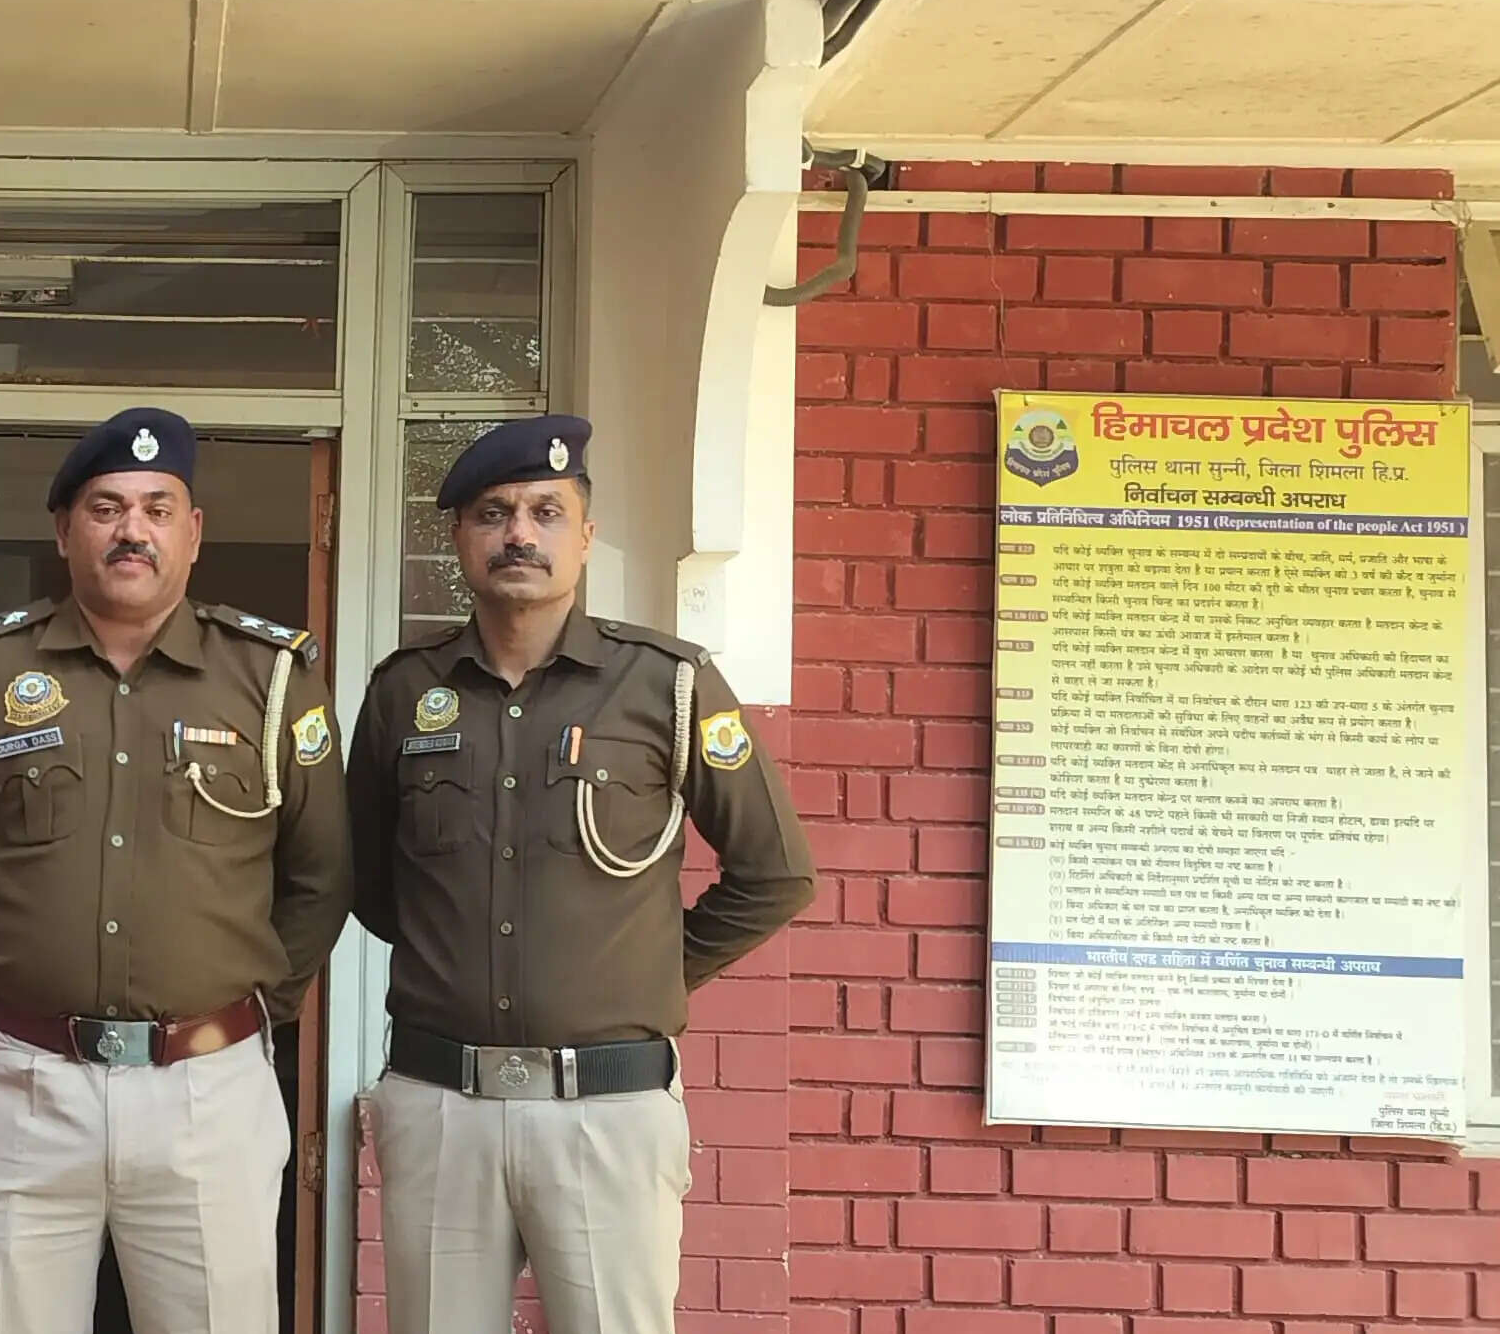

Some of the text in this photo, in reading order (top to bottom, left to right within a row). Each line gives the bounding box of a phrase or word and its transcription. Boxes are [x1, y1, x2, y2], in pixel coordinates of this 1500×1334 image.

[1091, 402, 1438, 458] हिमाचल प्रदेश पुलिस
[1110, 454, 1157, 478] पुलिस
[1165, 461, 1201, 475] थाना
[1259, 457, 1301, 477] जिला
[1309, 459, 1365, 480] शिमला
[1124, 482, 1346, 508] निर्वाचन सम्बन्धी अपराध
[1001, 508, 1031, 525] लोक
[1038, 509, 1103, 524] प्रतिनिधित्व
[1111, 510, 1171, 526] अधिनियम
[1178, 516, 1208, 527] 1951
[1214, 516, 1313, 529] (Representation
[1318, 518, 1331, 531] of
[1331, 519, 1353, 532] the
[1357, 521, 1397, 533] people
[1403, 522, 1422, 532] Act
